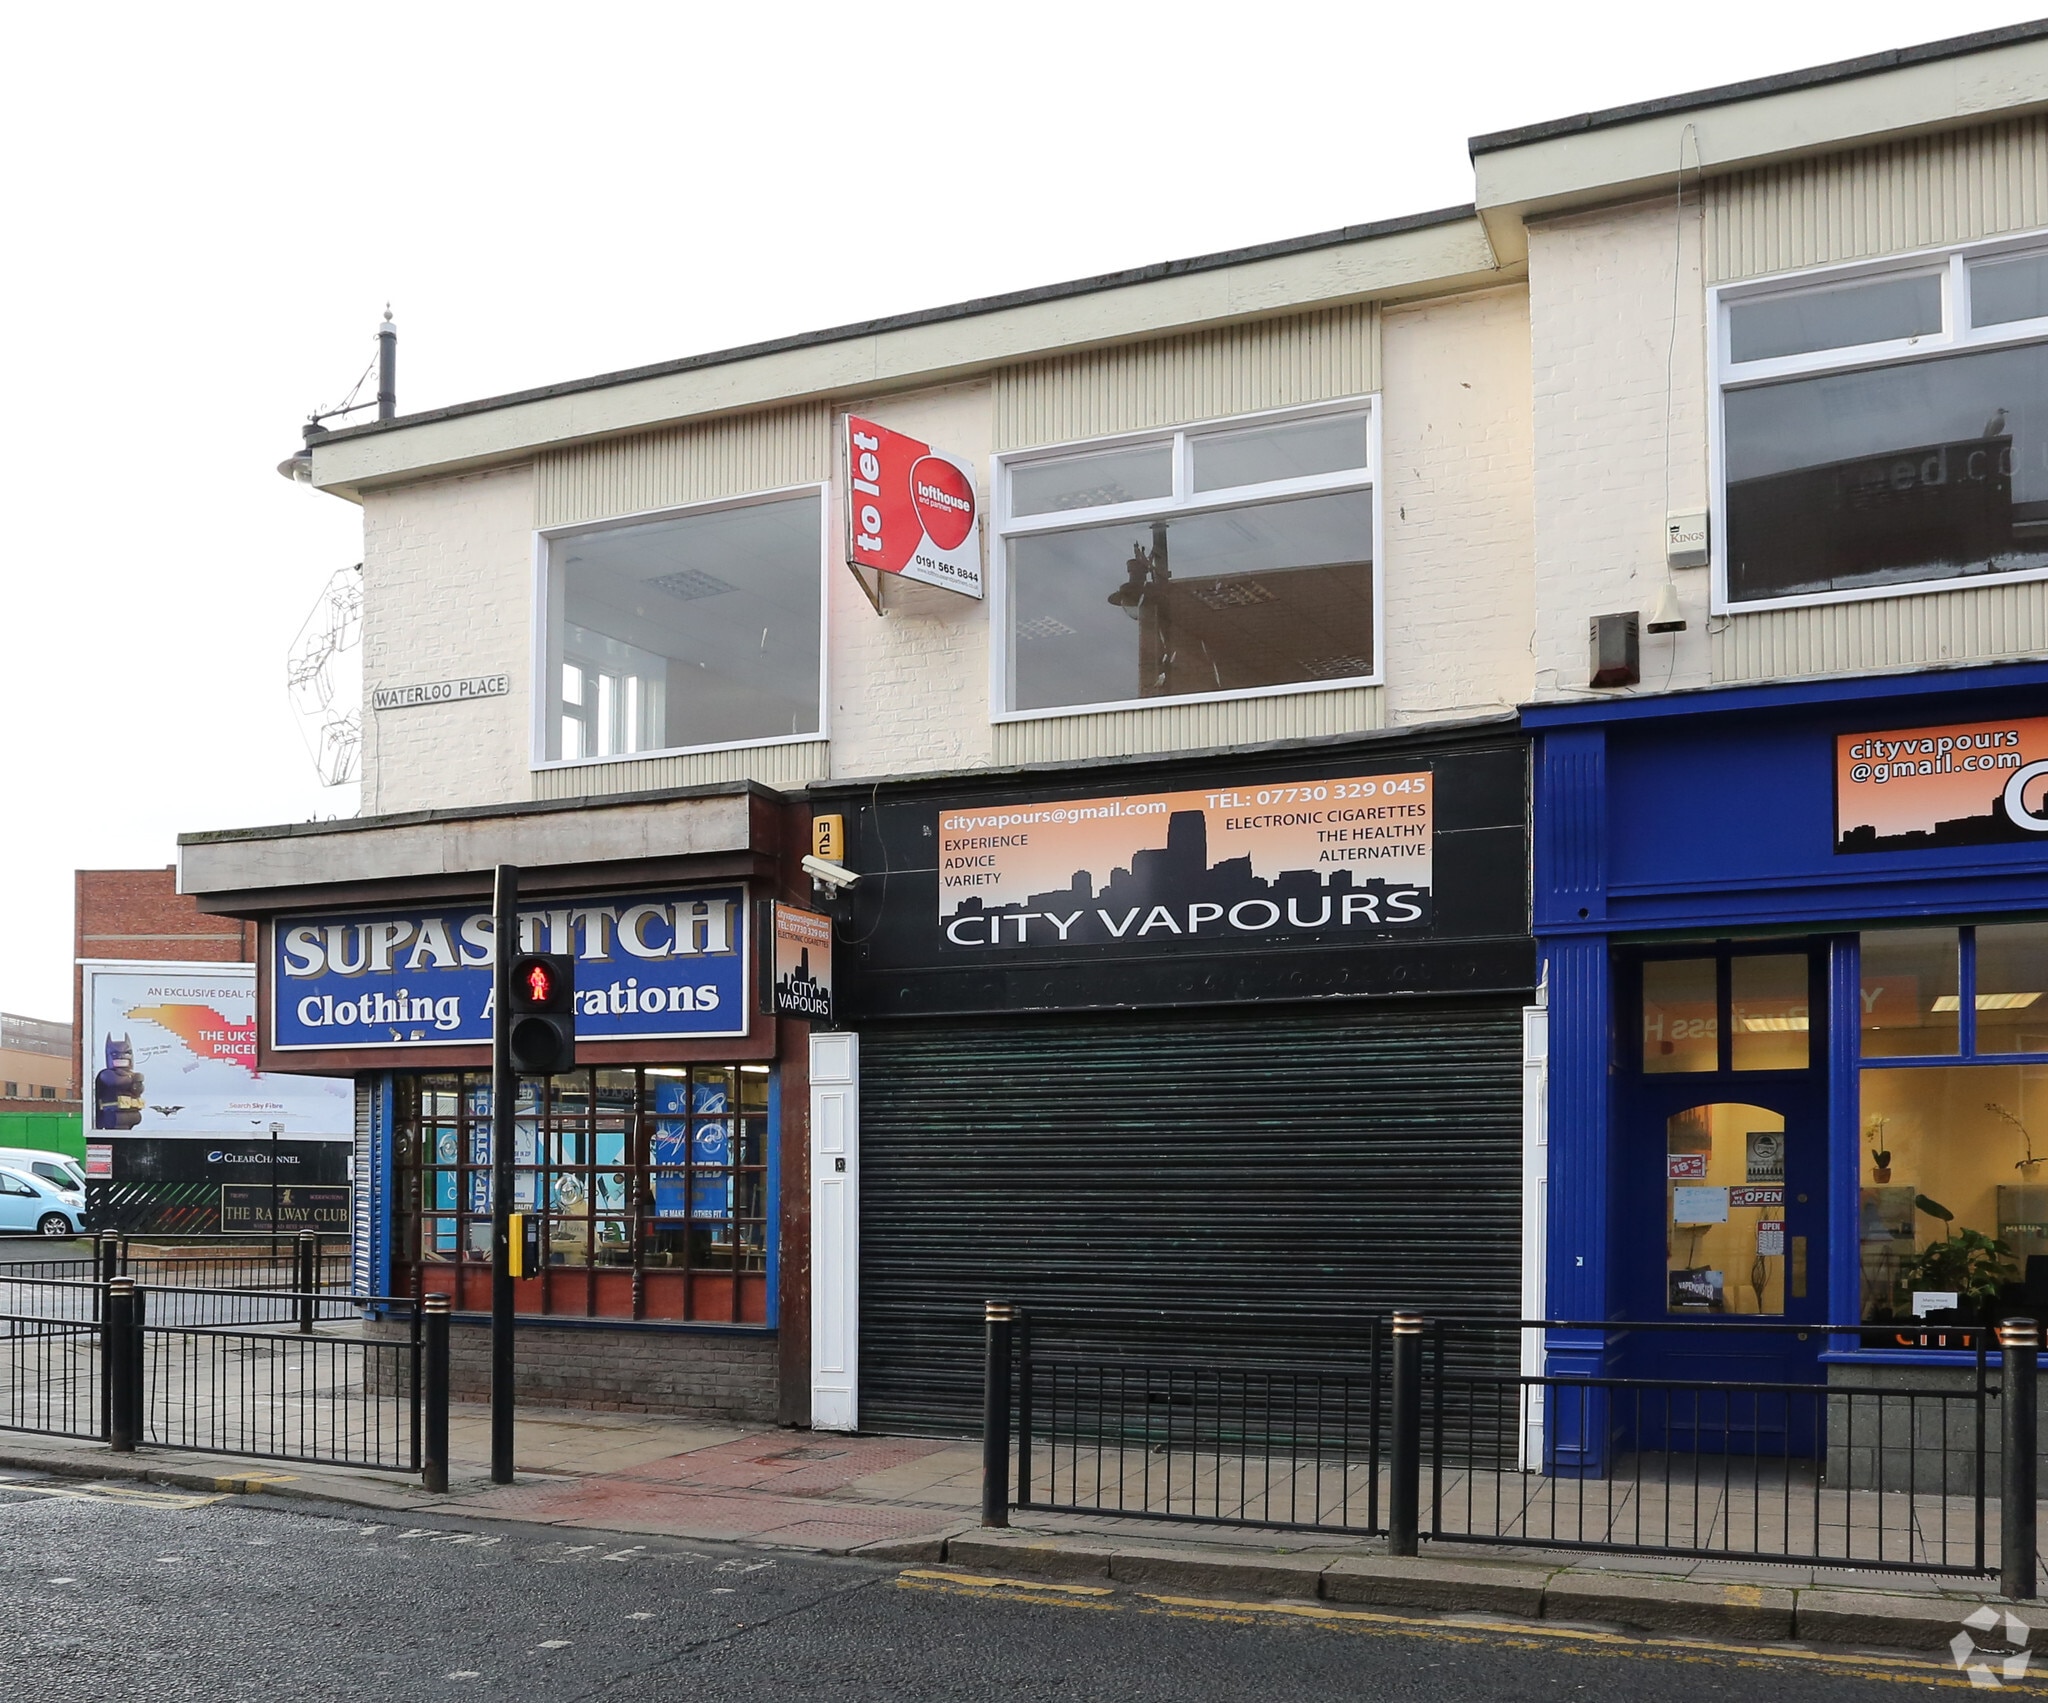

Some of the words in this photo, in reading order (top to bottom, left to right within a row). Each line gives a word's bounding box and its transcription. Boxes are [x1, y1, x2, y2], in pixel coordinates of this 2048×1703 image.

[853, 432, 881, 497] let
[917, 480, 971, 512] lofthouse
[857, 505, 882, 551] to
[1671, 532, 1705, 544] KINGS
[916, 555, 936, 569] 0191
[938, 562, 955, 575] 565
[957, 568, 978, 582] 8844
[376, 684, 452, 706] WATERLOO
[460, 677, 505, 696] PLACE
[1850, 730, 2019, 761] cityvapours
[1850, 752, 2022, 783] @gmail.com
[944, 801, 1167, 832] cityvapours@gmail.com
[1205, 792, 1251, 809] TEL:
[1256, 786, 1328, 805] 07730
[1333, 781, 1377, 800] 329
[1381, 778, 1426, 795] 045
[1226, 811, 1323, 830] ELECTRONIC
[1327, 804, 1426, 822] CIGARETTES
[944, 834, 1028, 851] EXPERIENCE
[1317, 829, 1348, 843] THE
[1353, 823, 1426, 841] HEALTHY
[944, 855, 996, 869] ADVICE
[1319, 843, 1426, 862] ALTERNATIVE
[944, 873, 1002, 887] VARIETY
[946, 910, 1084, 946] CITY
[1096, 890, 1423, 938] VAPOURS
[283, 899, 730, 977] SUPASTITCH
[147, 987, 162, 996] AN
[164, 988, 216, 998] EXCLUSIVE
[218, 989, 244, 998] DEAL
[792, 980, 816, 998] CITY
[297, 988, 461, 1030] Clothing
[779, 992, 829, 1015] VAPOURS
[198, 1030, 225, 1041] THE
[252, 1102, 264, 1110] Sky
[1744, 1191, 1783, 1202] OPEN
[225, 1206, 251, 1220] THE
[255, 1206, 310, 1221] RALWAY
[314, 1207, 348, 1222] CLUB
[1761, 1222, 1781, 1231] OPEN
